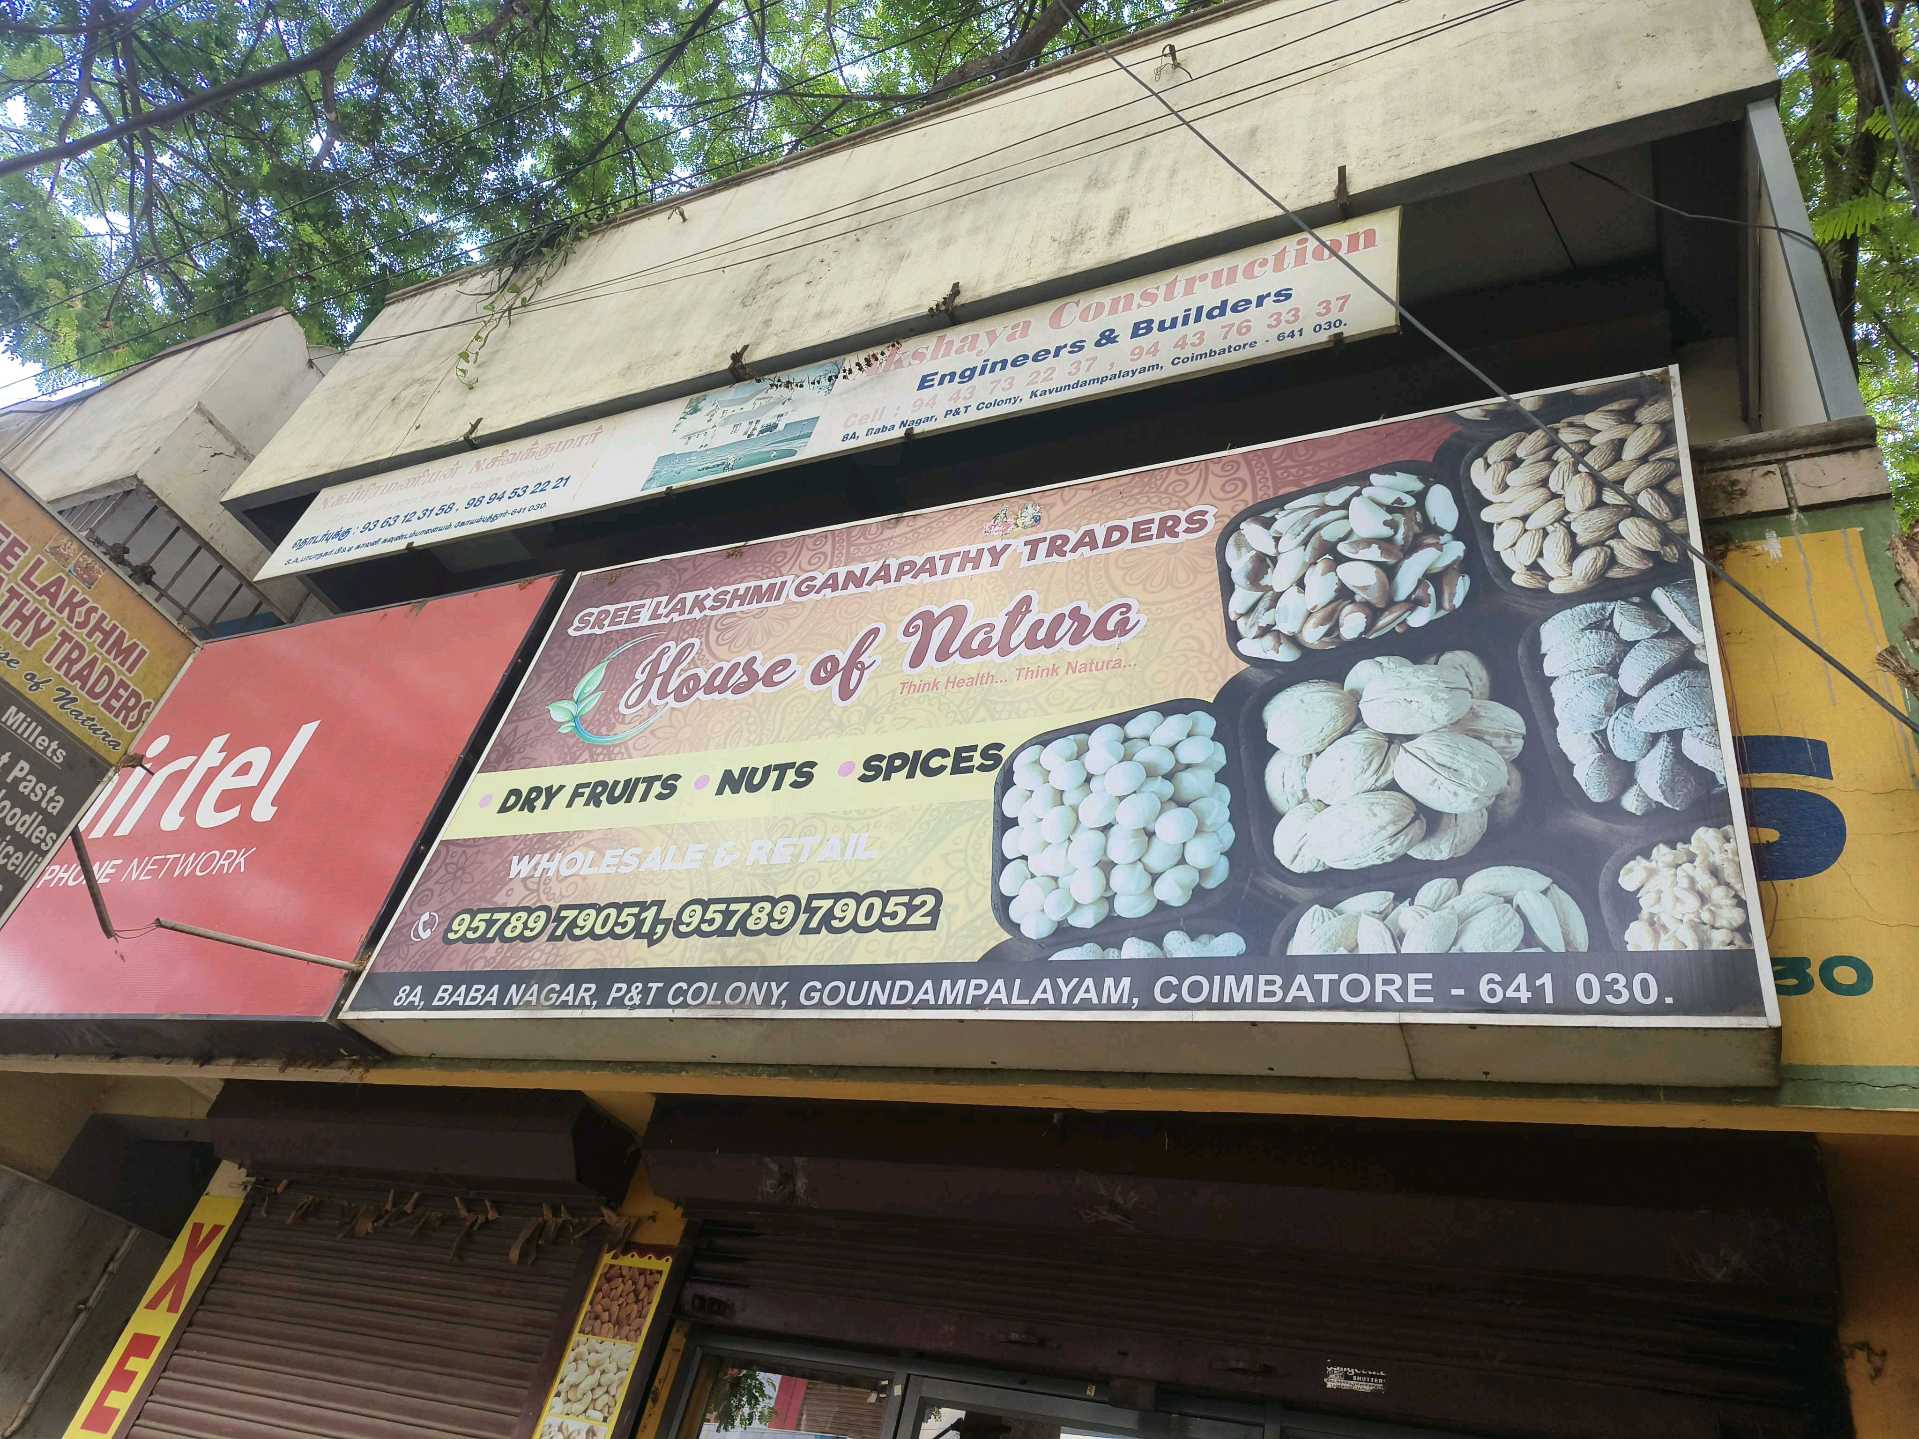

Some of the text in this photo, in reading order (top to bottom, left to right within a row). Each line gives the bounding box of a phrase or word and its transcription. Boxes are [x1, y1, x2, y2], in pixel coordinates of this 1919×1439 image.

[1048, 227, 1378, 330] Construction
[843, 405, 887, 429] Cell
[911, 395, 937, 412] 94
[951, 385, 977, 402] 43
[990, 376, 1015, 395] 73
[1027, 366, 1056, 387] 22
[1067, 356, 1098, 377] 37
[1129, 340, 1160, 362] 94
[1172, 330, 1206, 351] 43
[1220, 319, 1253, 341] 76
[1266, 307, 1301, 329] 33
[1315, 294, 1352, 318] 37
[899, 414, 938, 430] Nagar,
[943, 404, 971, 418] P&T
[976, 394, 1023, 411] Colony,
[1029, 362, 1164, 400] Kavundampalayam,
[1170, 340, 1258, 366] Coimbatore
[1276, 327, 1303, 343] 641
[1312, 318, 1348, 334] 030.
[916, 287, 1293, 391] Engineers & Builders
[360, 519, 379, 534] 93
[380, 514, 400, 529] 63
[401, 511, 417, 524] 12
[417, 506, 435, 521] 31
[464, 495, 485, 510] 98
[486, 490, 506, 505] 94
[508, 485, 529, 500] 53
[529, 480, 551, 495] 22
[552, 474, 572, 490] 21
[571, 506, 1216, 633] SREE LAKSHMI GANAPATHY TRADERS
[18, 554, 149, 676] LAKSHMI
[0, 575, 152, 733] THY TRADERS
[622, 594, 1143, 713] House of Natura
[899, 656, 1137, 696] Think Health... Think Natura...
[1, 705, 66, 764] Millets
[24, 672, 53, 692] of
[53, 687, 122, 751] Natura
[6, 760, 65, 815] Pasta
[76, 720, 321, 839] irtel
[497, 742, 1006, 815] DRY FRUITS NUTS SPICES
[0, 789, 56, 850] oodles
[507, 841, 704, 881] WHOLESALE
[744, 832, 878, 866] RETAIL
[120, 847, 257, 883] NETWORK
[447, 888, 940, 943] 95789 79051, 95789 79052
[392, 985, 425, 1010] 8A,
[431, 983, 499, 1007] BABA
[503, 982, 598, 1010] NAGAR,
[605, 981, 664, 1008] P&T
[667, 979, 789, 1010] COLONY,
[799, 976, 1138, 1009] GOUNDAMPALAYAM,
[1153, 973, 1435, 1005] COIMBATORE
[1477, 971, 1556, 1006] 641
[1575, 971, 1675, 1006] 030.
